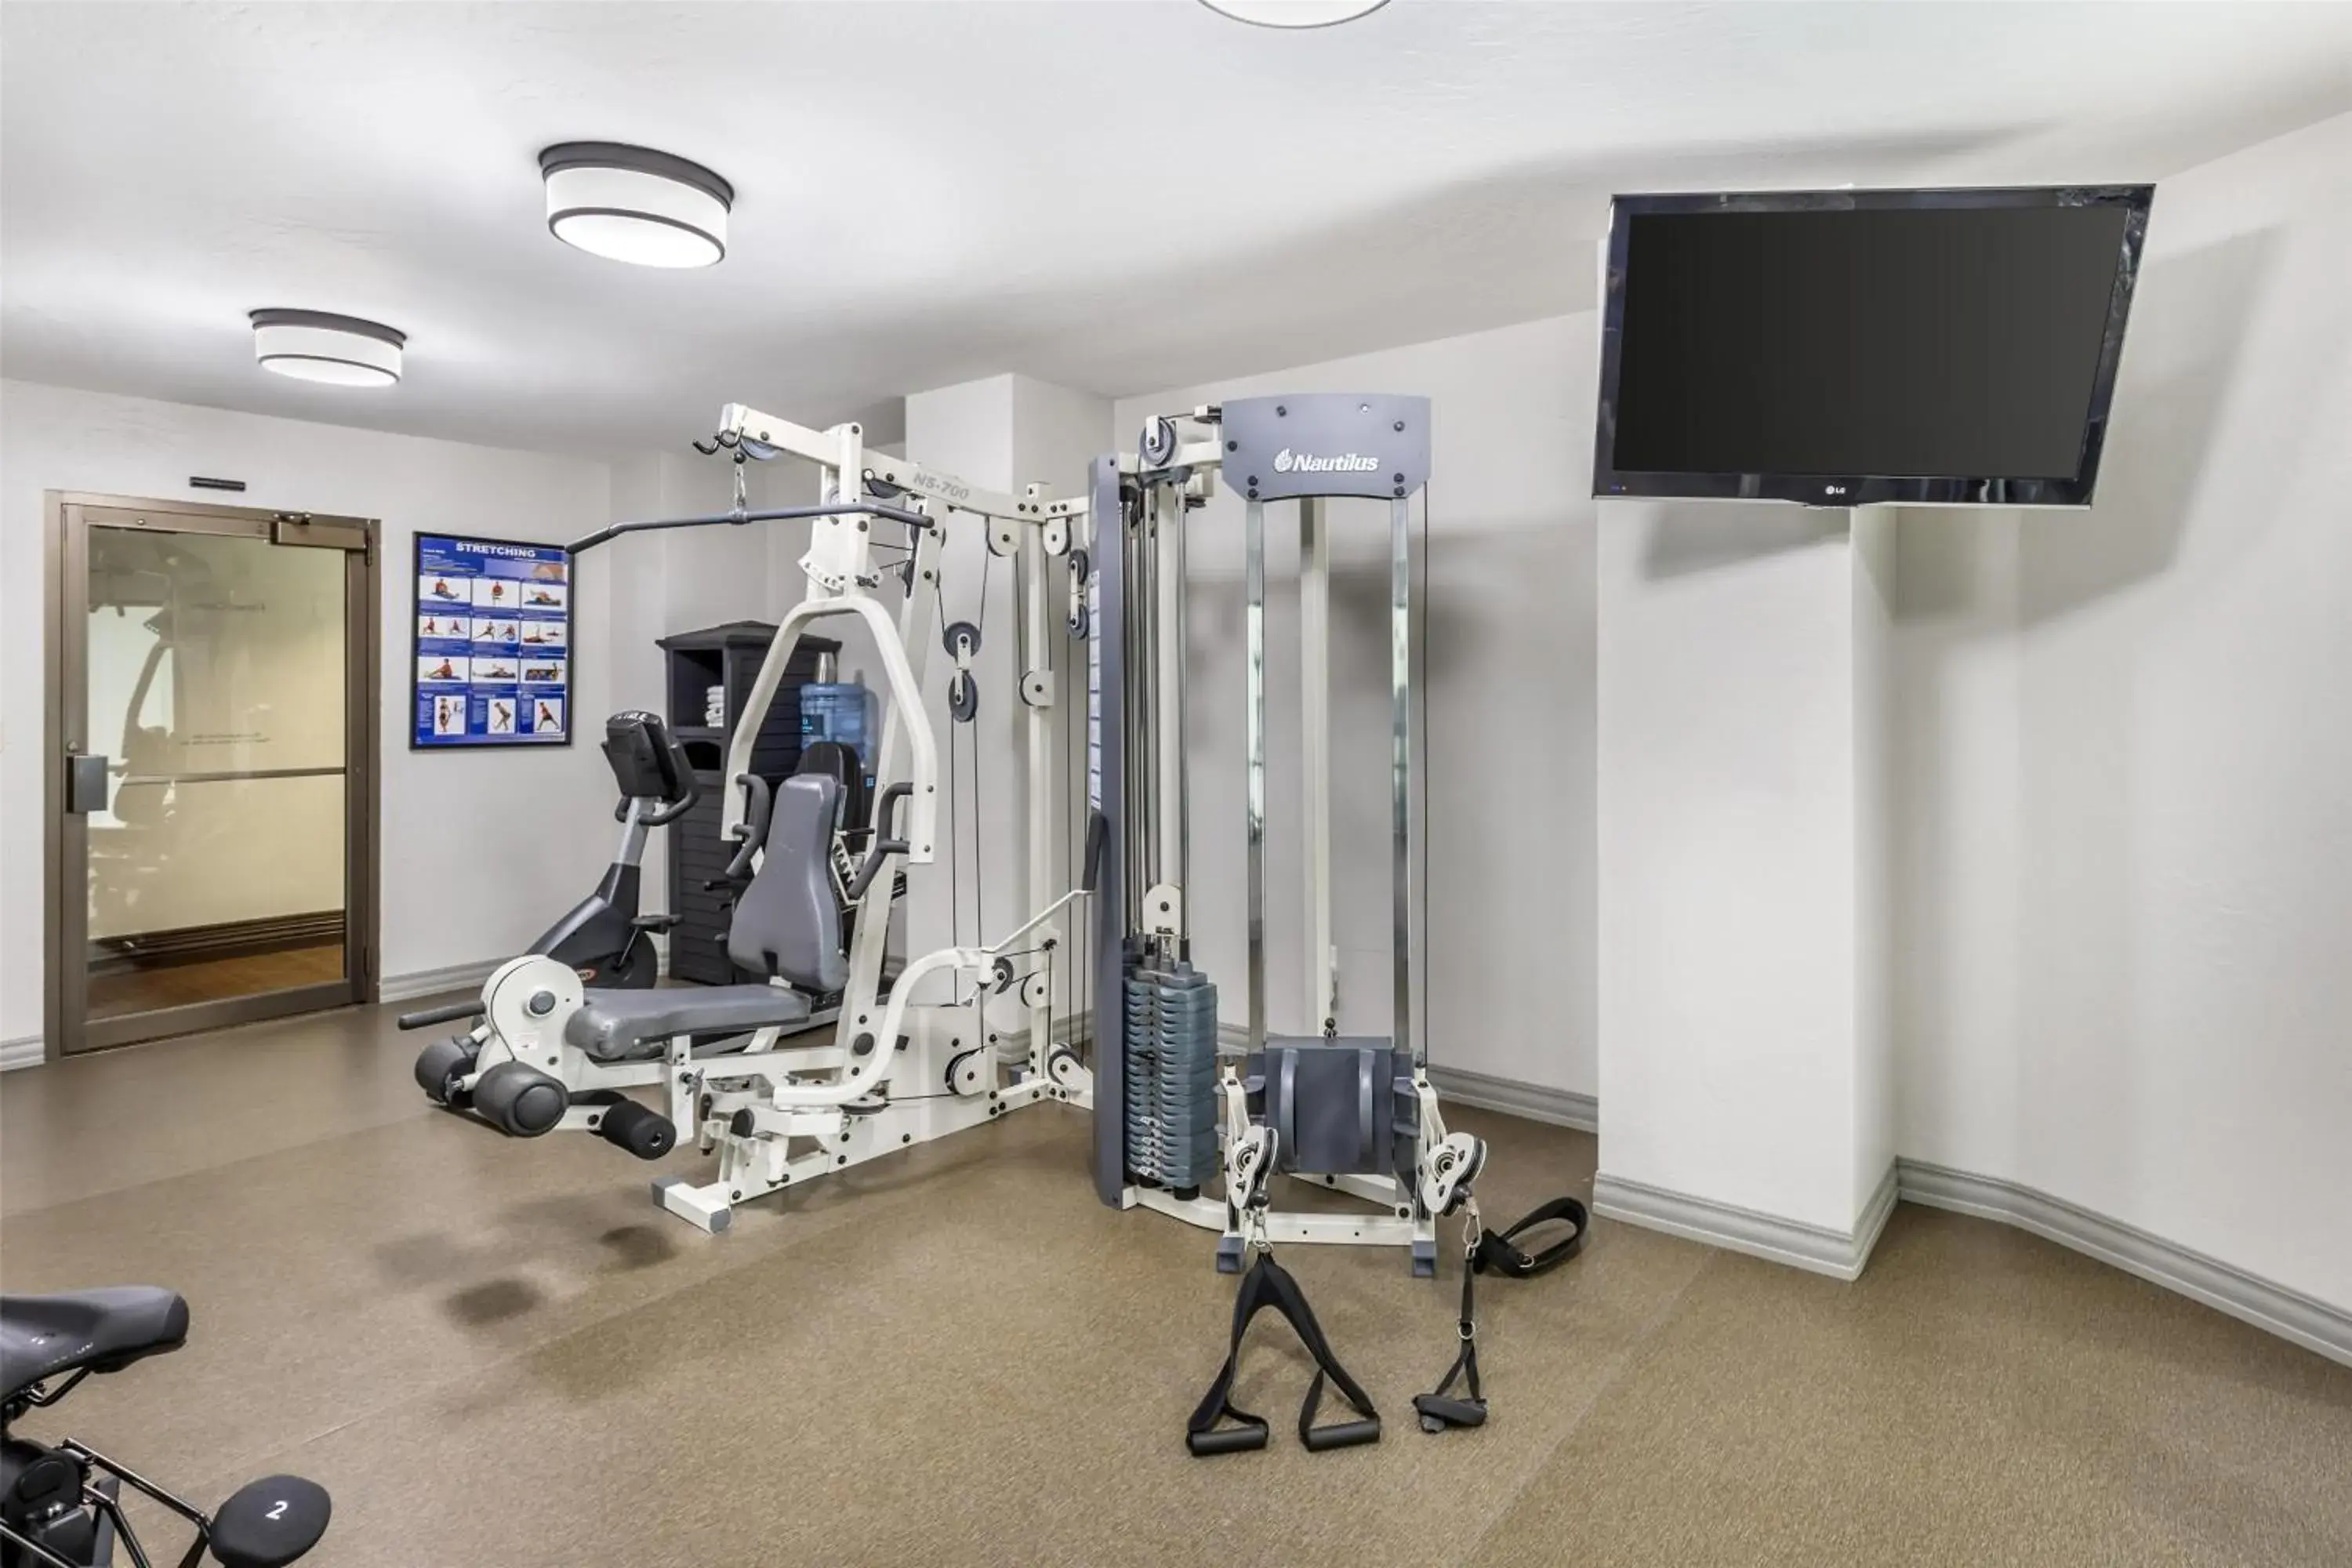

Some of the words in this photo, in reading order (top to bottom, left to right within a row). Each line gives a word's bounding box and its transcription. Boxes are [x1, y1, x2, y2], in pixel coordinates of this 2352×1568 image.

[1292, 453, 1379, 471] Nautilus
[456, 543, 536, 558] STRETCHING
[265, 1500, 289, 1520] 2
